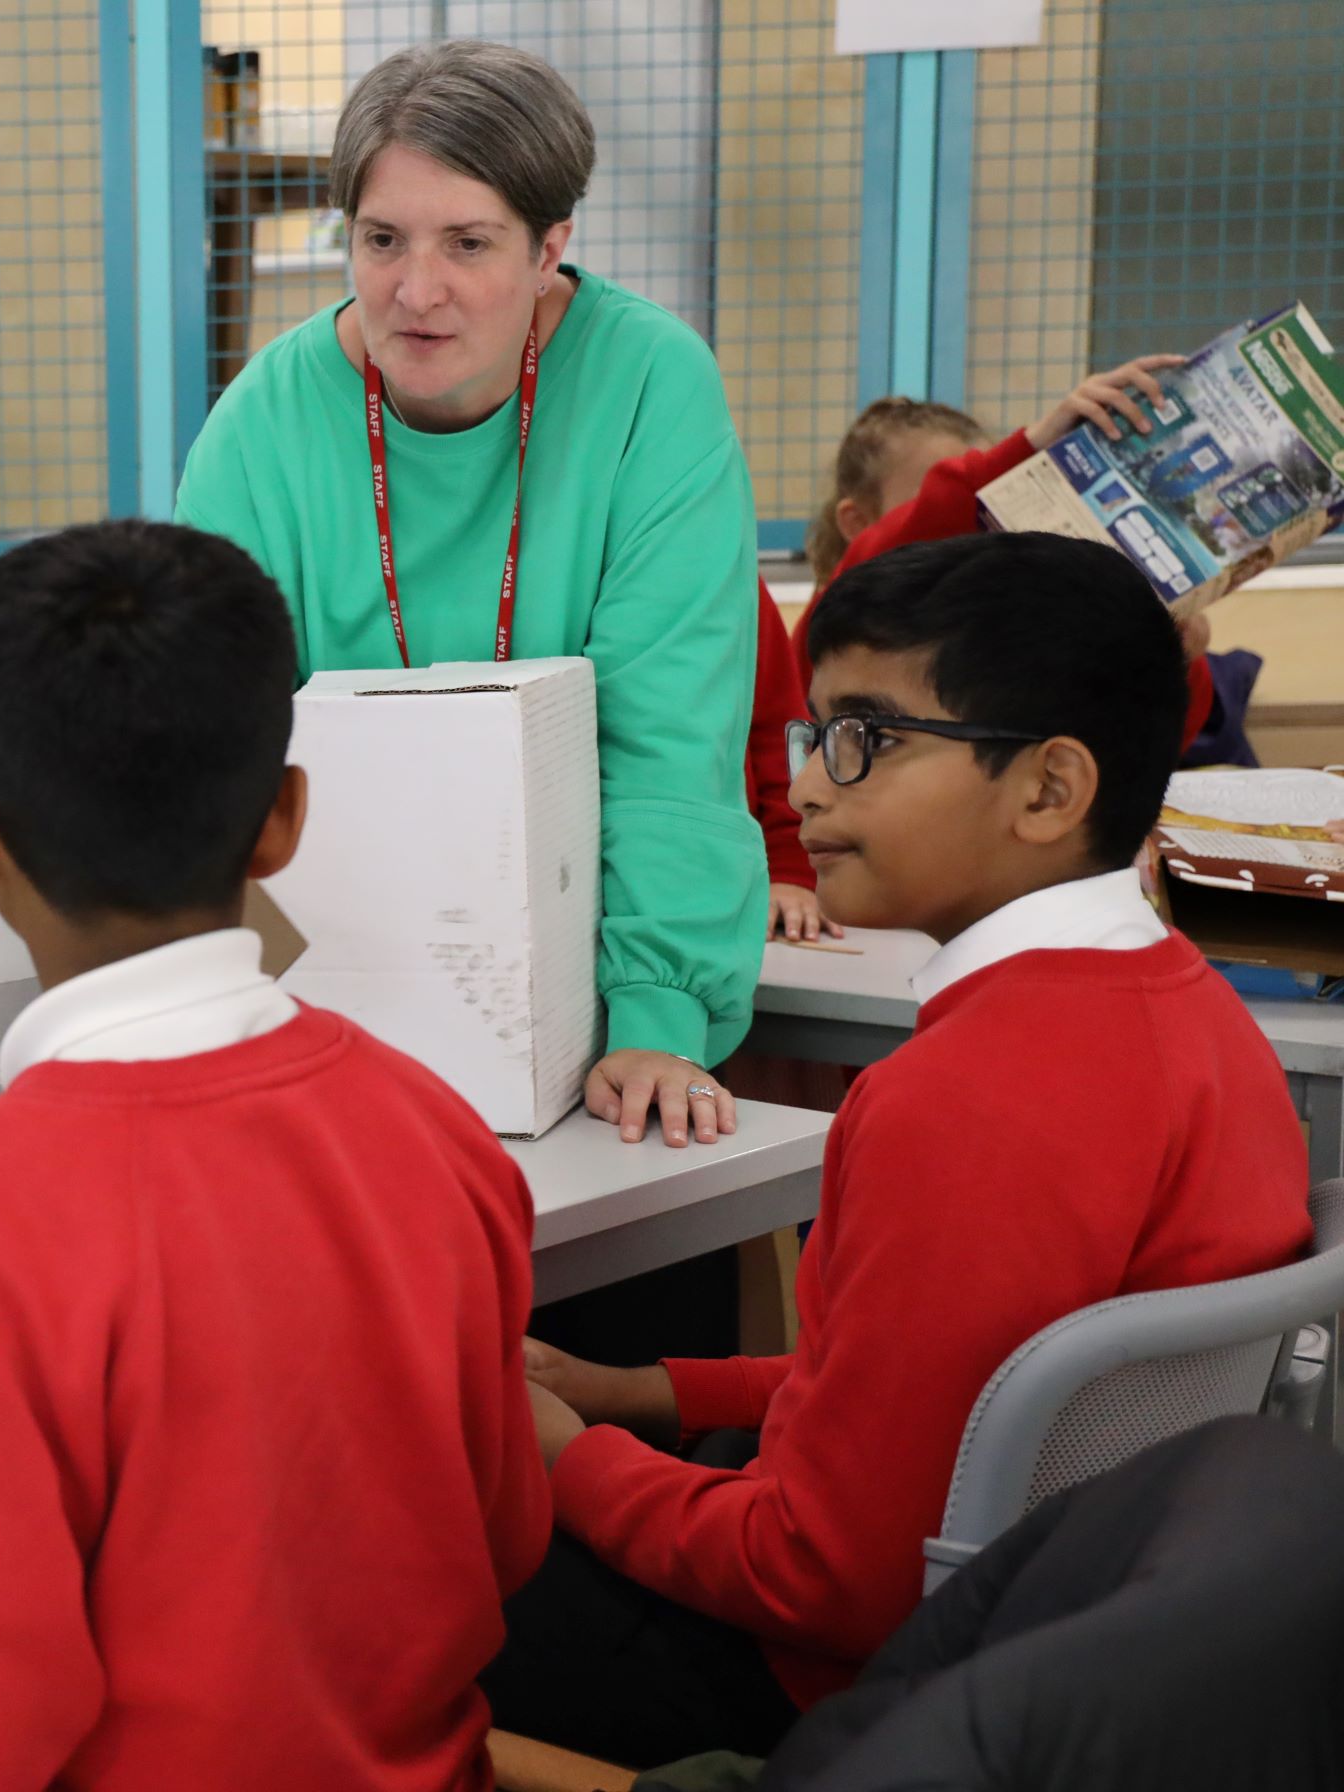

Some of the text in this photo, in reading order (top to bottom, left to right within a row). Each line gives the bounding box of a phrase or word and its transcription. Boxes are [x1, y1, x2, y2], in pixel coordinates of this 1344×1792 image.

[368, 393, 380, 437] STAFF
[1228, 364, 1279, 427] AVATAR
[520, 401, 531, 447] STAFF
[373, 464, 384, 508] STAFF
[380, 535, 392, 577] STAFF
[502, 555, 513, 598] STAFF
[496, 626, 506, 661] TAFF
